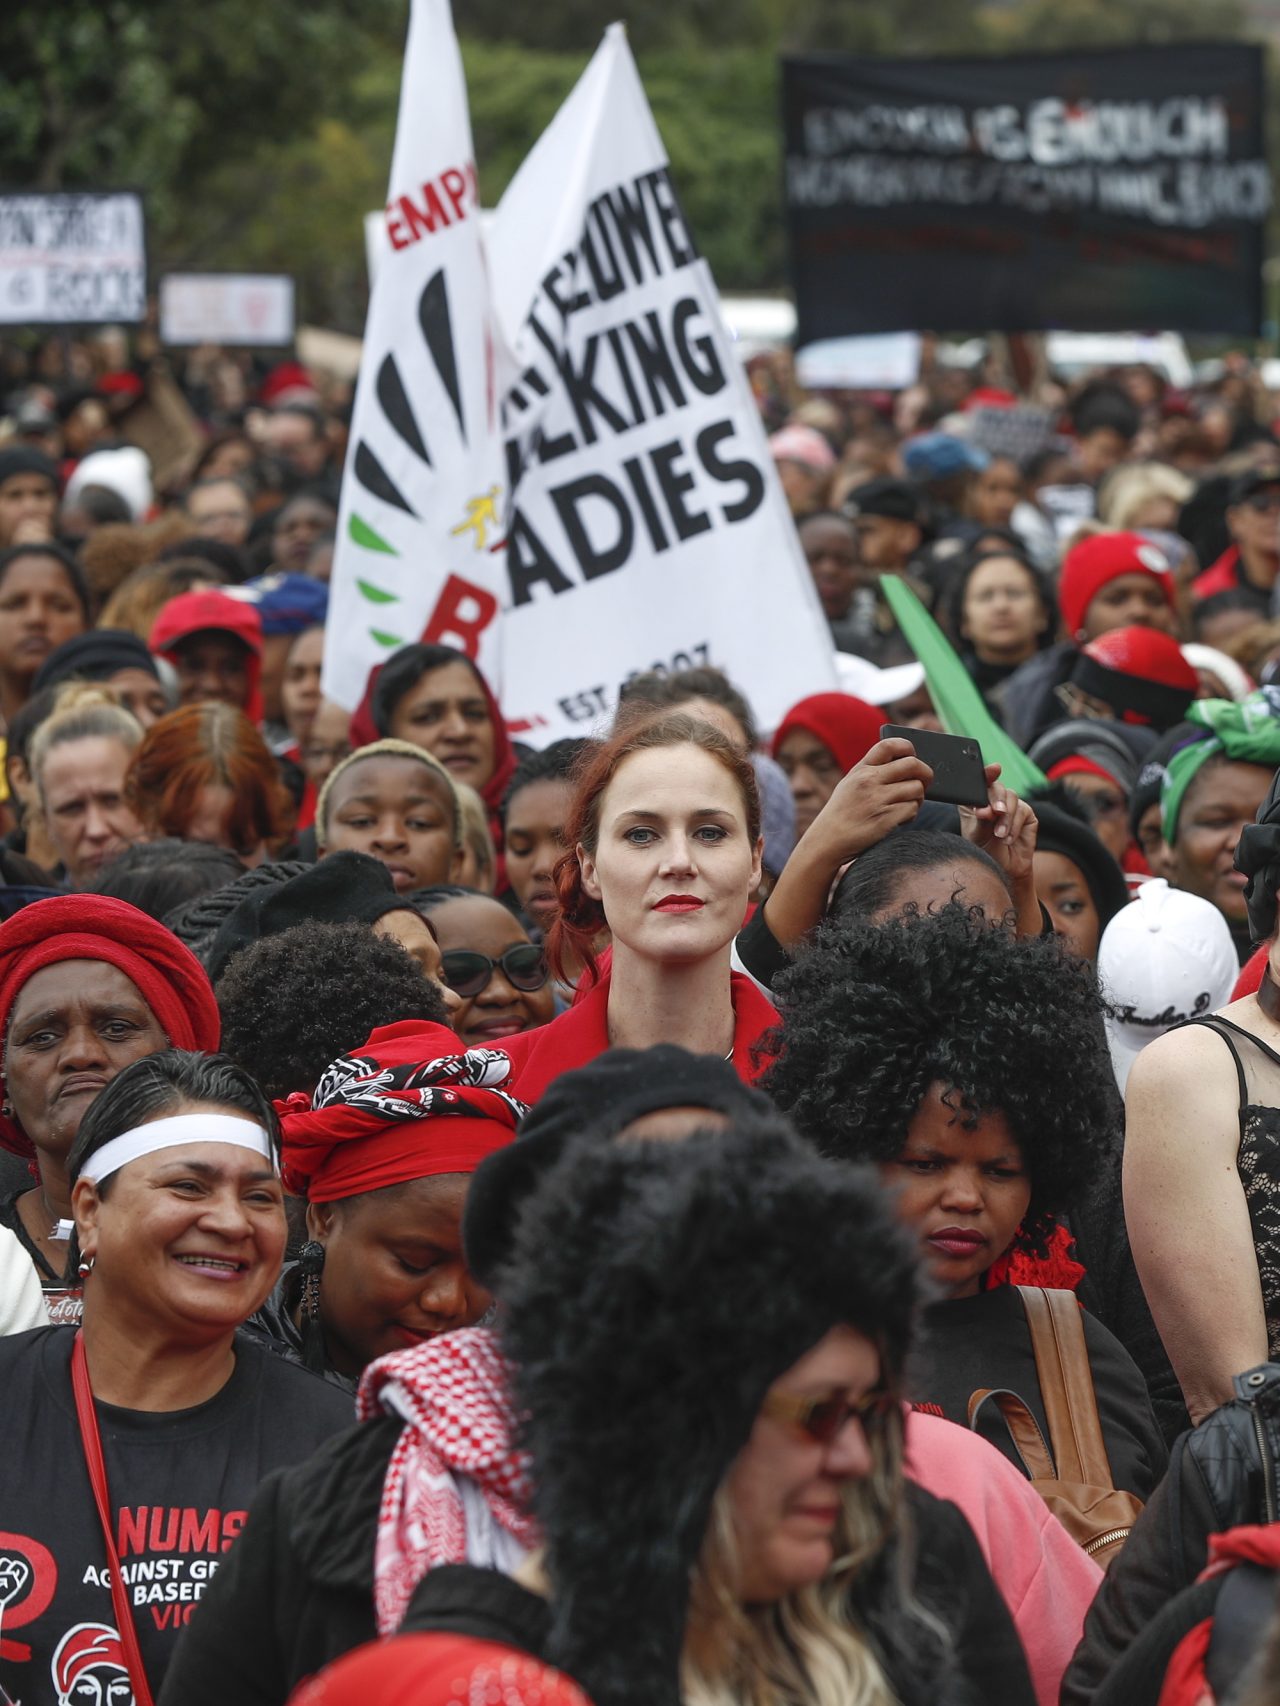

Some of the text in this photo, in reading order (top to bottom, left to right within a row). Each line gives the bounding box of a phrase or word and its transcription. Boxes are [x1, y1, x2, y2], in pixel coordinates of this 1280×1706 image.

[503, 418, 766, 608] ADIES
[557, 686, 609, 722] EST
[82, 1559, 184, 1590] AGAINST
